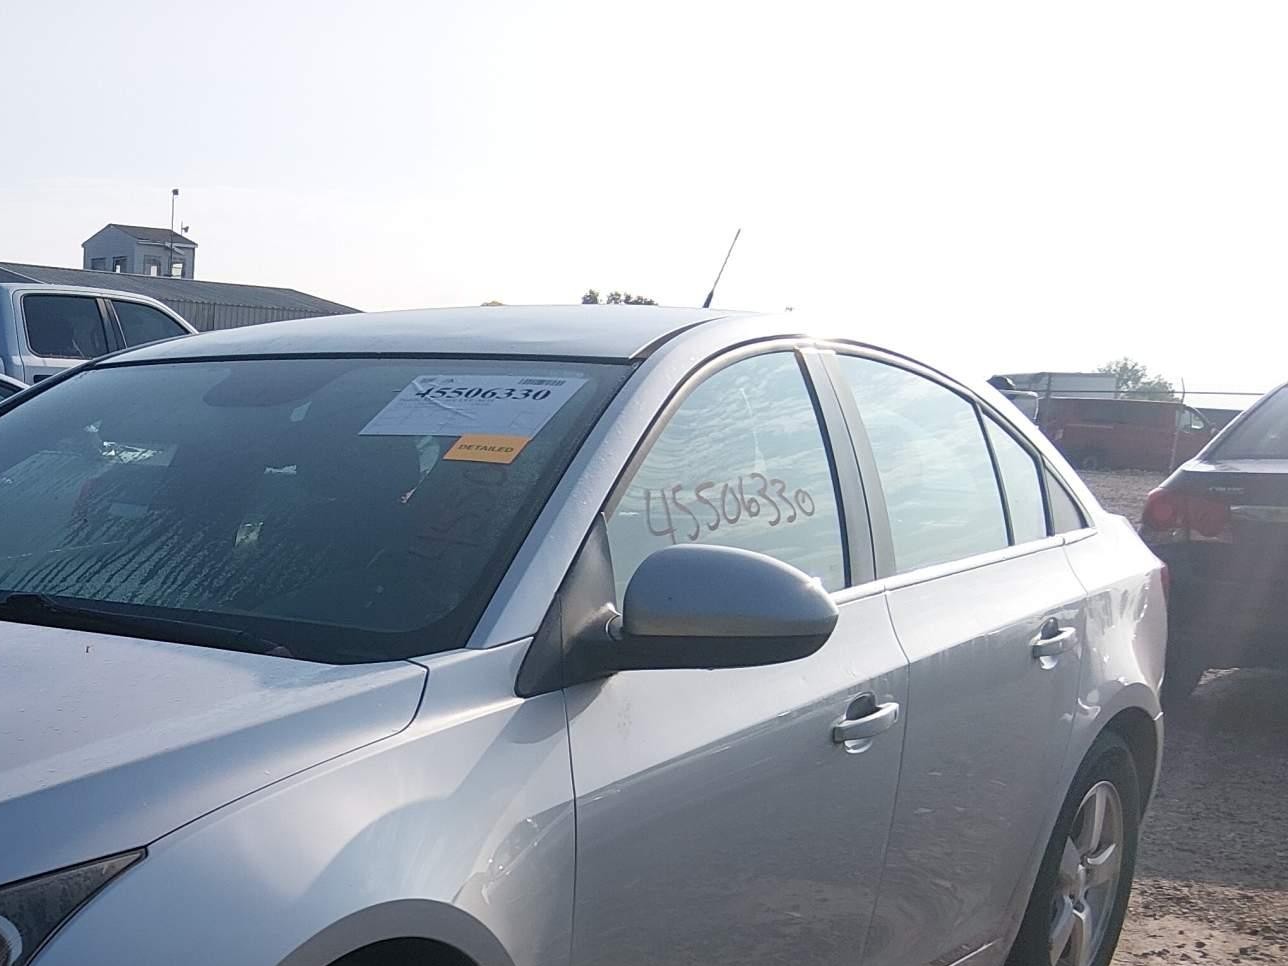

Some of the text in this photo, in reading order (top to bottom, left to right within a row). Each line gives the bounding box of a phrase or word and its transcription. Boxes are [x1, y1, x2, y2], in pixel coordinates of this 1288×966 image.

[415, 386, 552, 401] 45506330
[457, 443, 515, 453] DETAILED
[644, 472, 816, 545] 45506330
